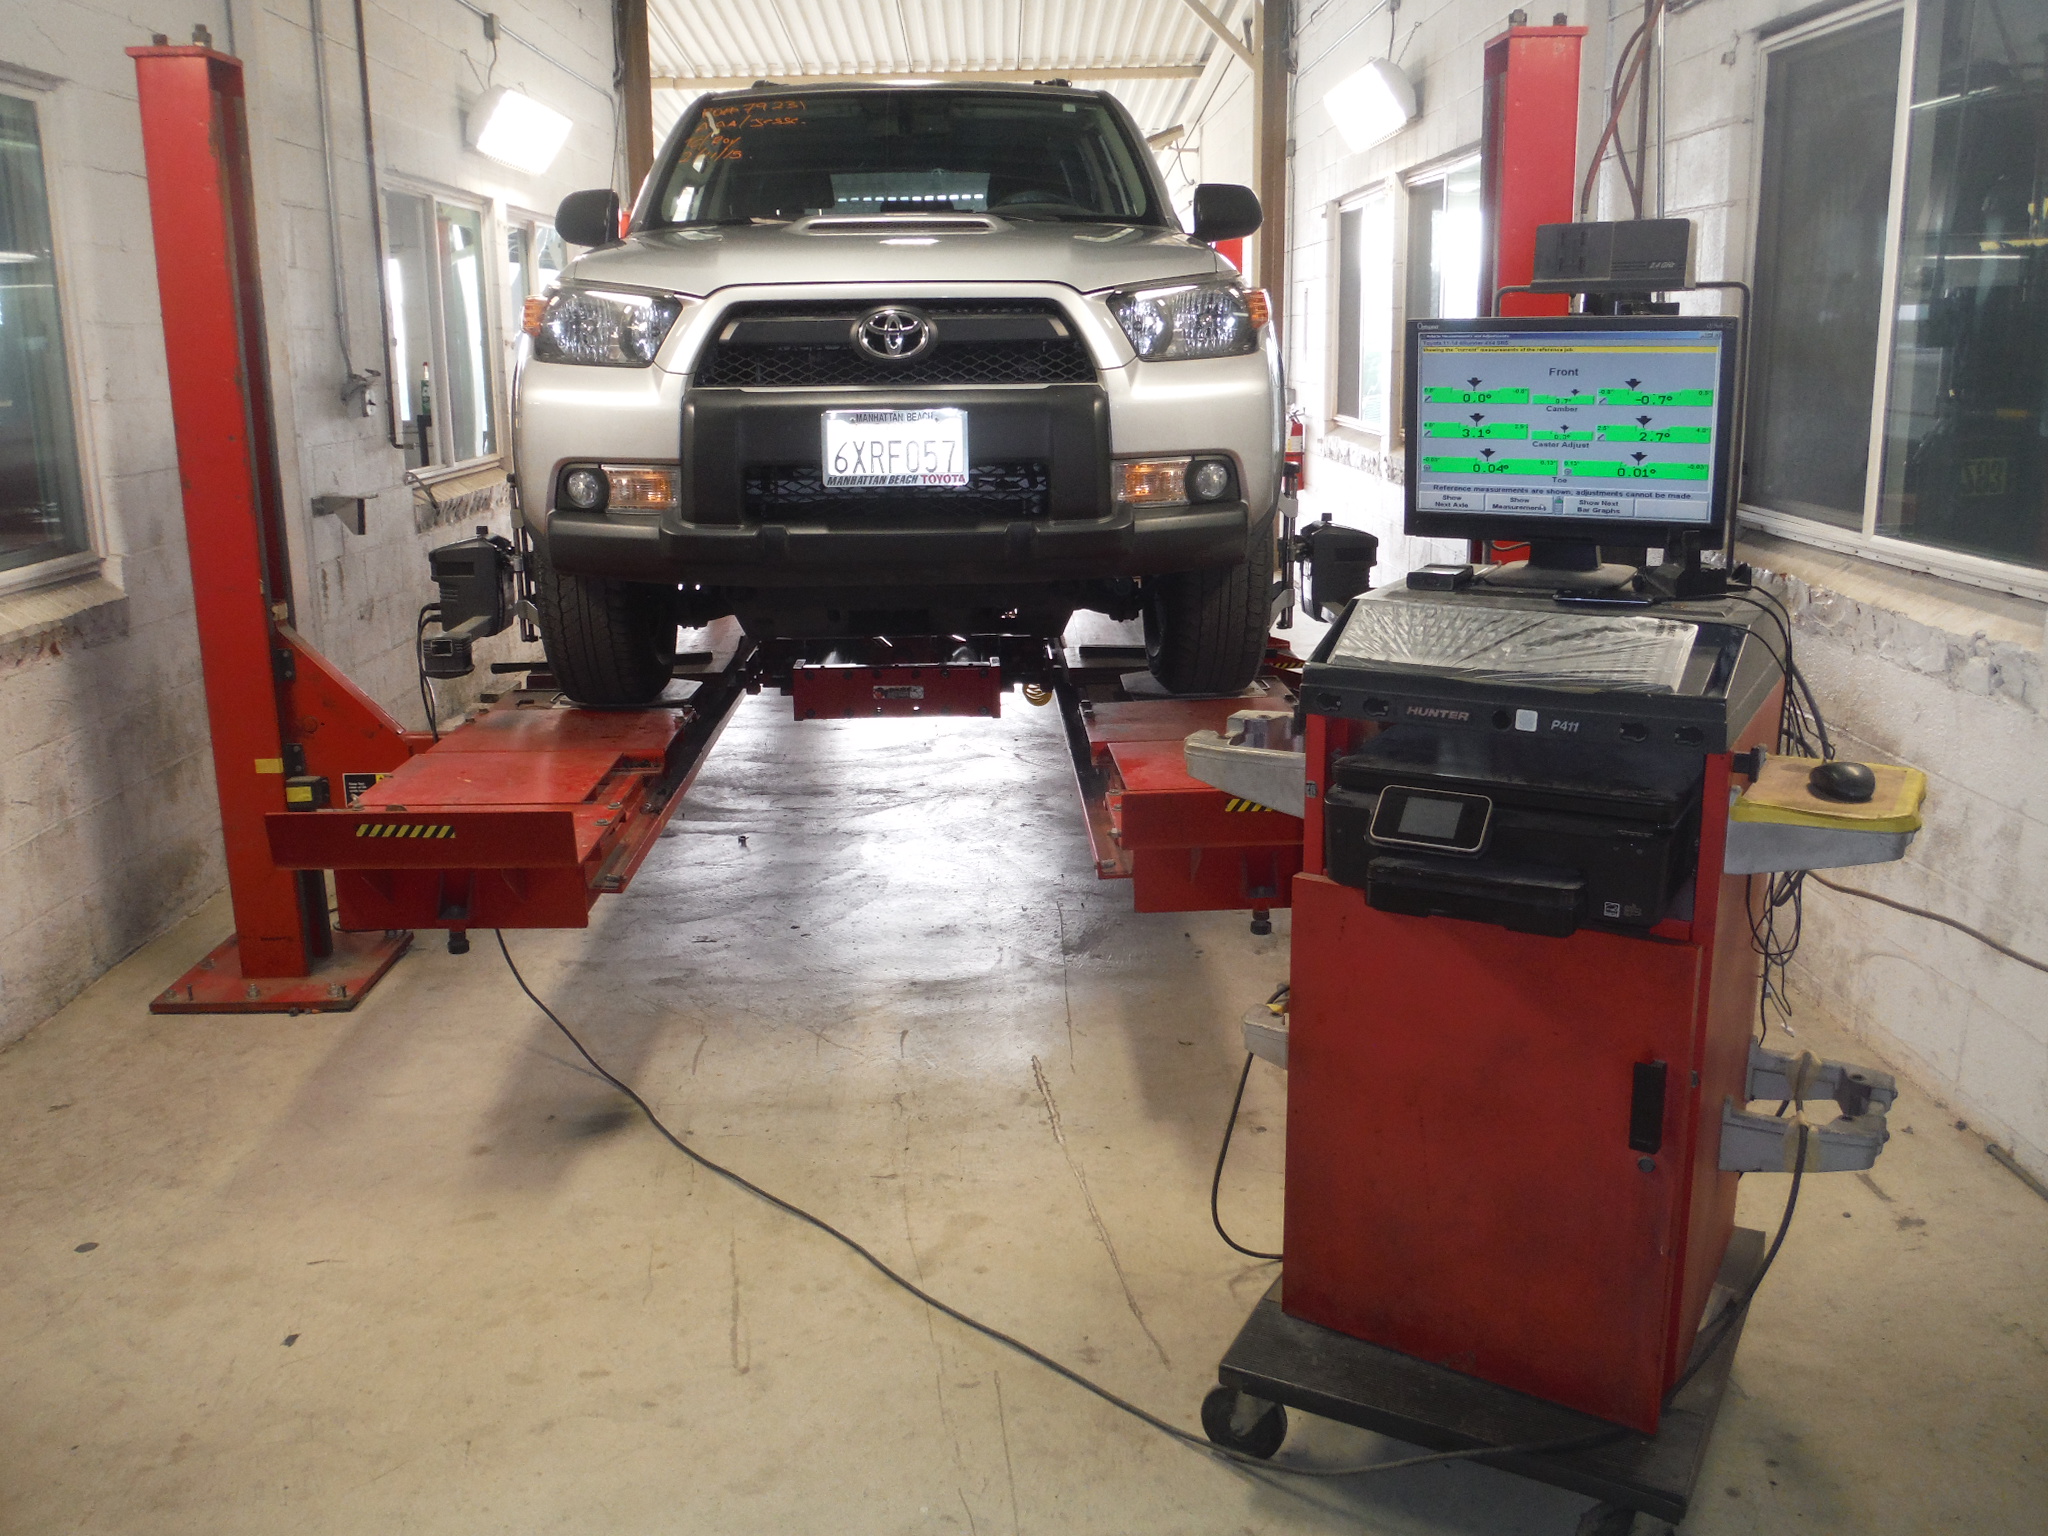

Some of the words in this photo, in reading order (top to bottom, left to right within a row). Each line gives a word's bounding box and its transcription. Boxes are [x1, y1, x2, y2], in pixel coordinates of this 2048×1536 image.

[1549, 367, 1579, 377] Front
[856, 412, 903, 423] MANHATTAN
[906, 412, 934, 422] BEACH
[1561, 441, 1590, 449] Adjust
[834, 440, 956, 474] 6XRF057
[827, 475, 886, 486] MANHATTAN
[888, 475, 918, 485] BEACH
[920, 474, 966, 485] TOYOTA
[1433, 484, 1472, 492] Reference
[1576, 490, 1623, 498] adjustments
[1406, 705, 1470, 722] HUNTER
[1551, 719, 1580, 733] P411
